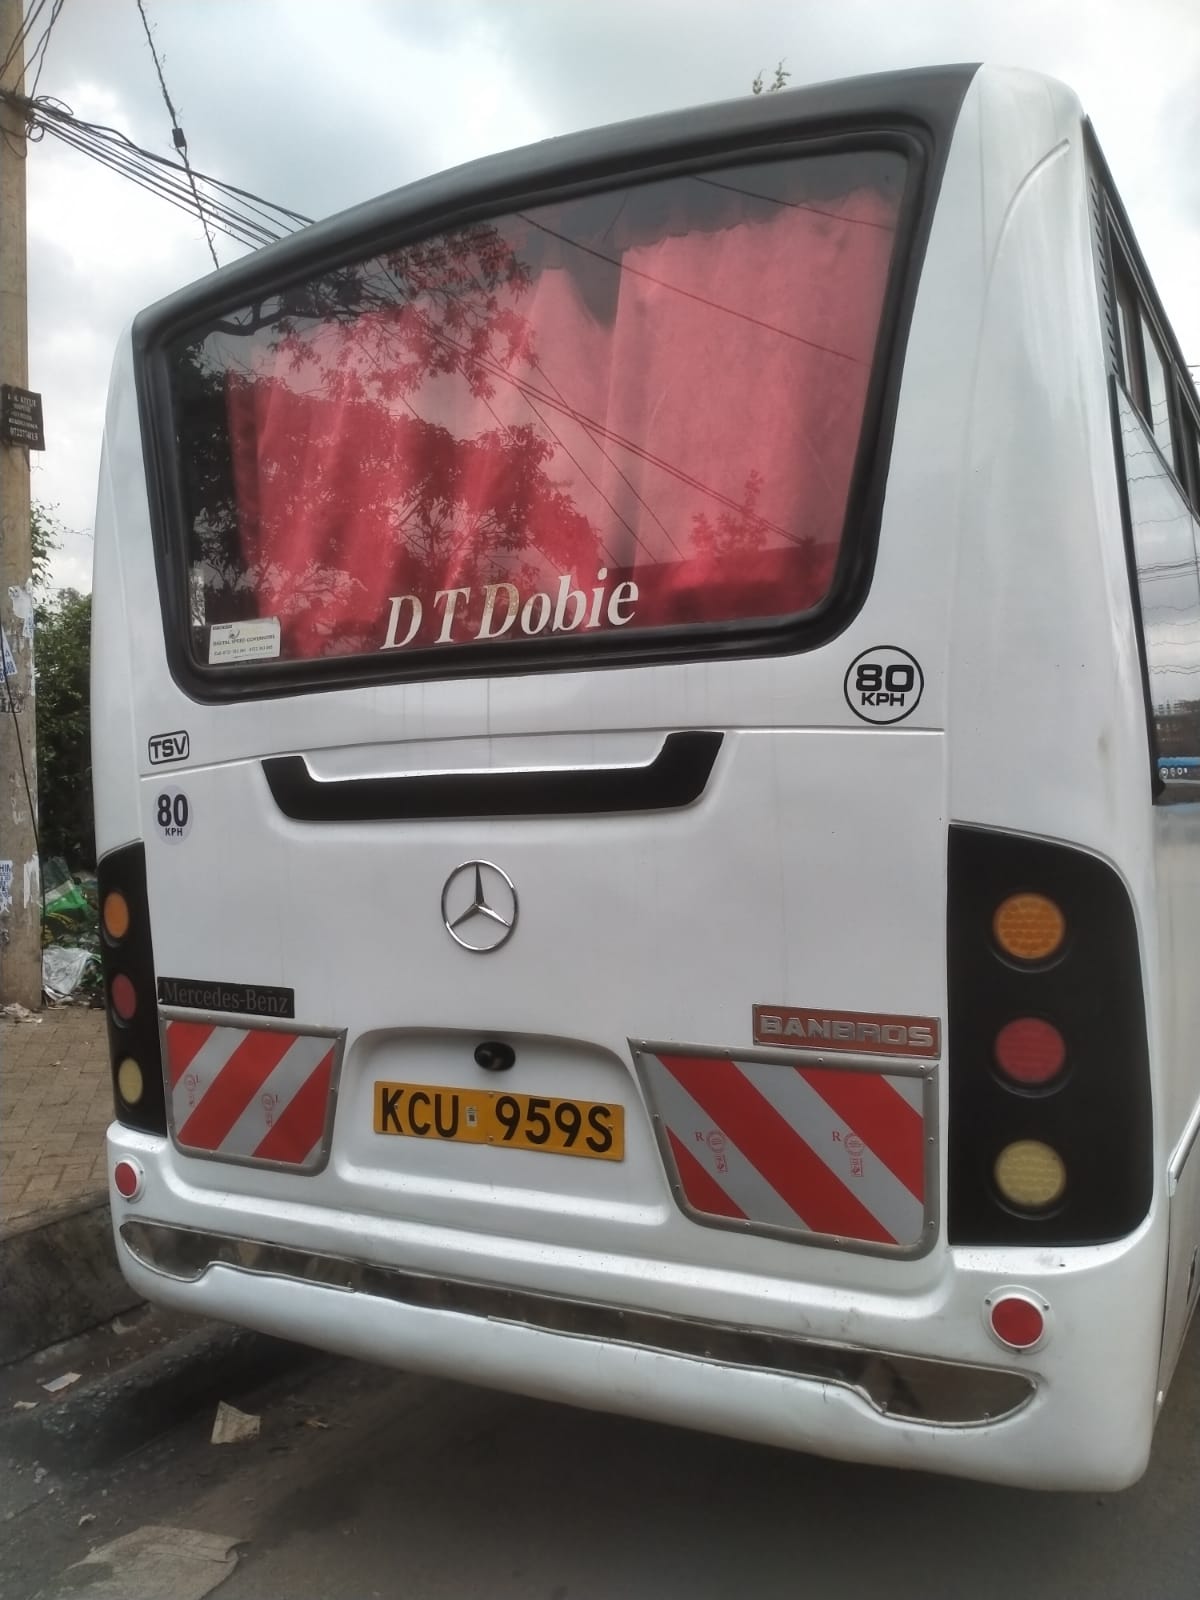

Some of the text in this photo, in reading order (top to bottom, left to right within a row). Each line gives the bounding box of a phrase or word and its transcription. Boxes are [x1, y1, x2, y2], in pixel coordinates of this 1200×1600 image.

[380, 568, 639, 650] D T Dobie
[856, 664, 914, 692] 80
[861, 692, 905, 706] KPH
[150, 736, 187, 760] TSV
[157, 794, 189, 828] 80
[164, 828, 183, 837] KPH
[162, 981, 289, 1014] Mercedes-Benz
[760, 1014, 934, 1048] BANBROS
[381, 1087, 613, 1153] KCU 959S
